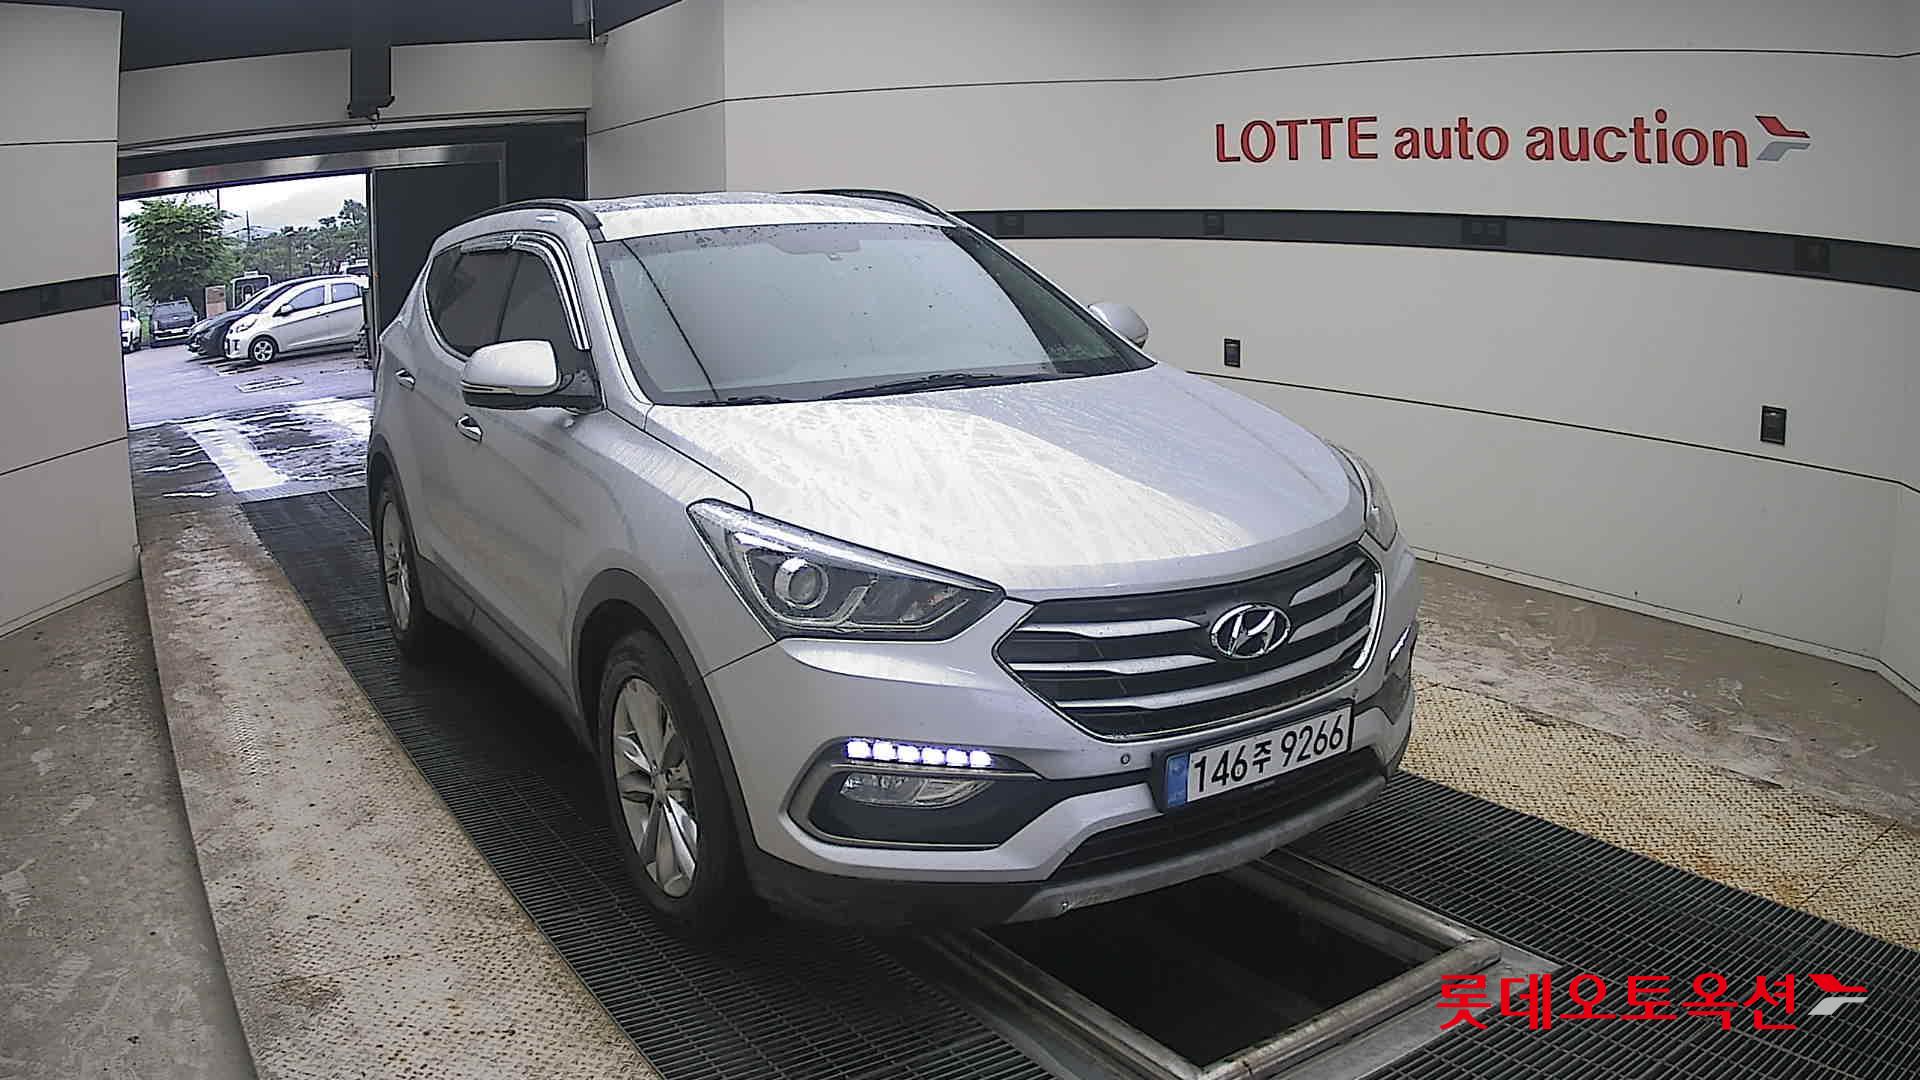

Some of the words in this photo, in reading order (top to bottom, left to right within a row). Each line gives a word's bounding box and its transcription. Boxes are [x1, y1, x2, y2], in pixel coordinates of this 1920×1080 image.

[1215, 116, 1379, 163] LOTTE
[1393, 116, 1510, 160] auto
[1525, 109, 1749, 168] auction
[1193, 740, 1272, 793] 146주
[1280, 714, 1344, 767] 9266
